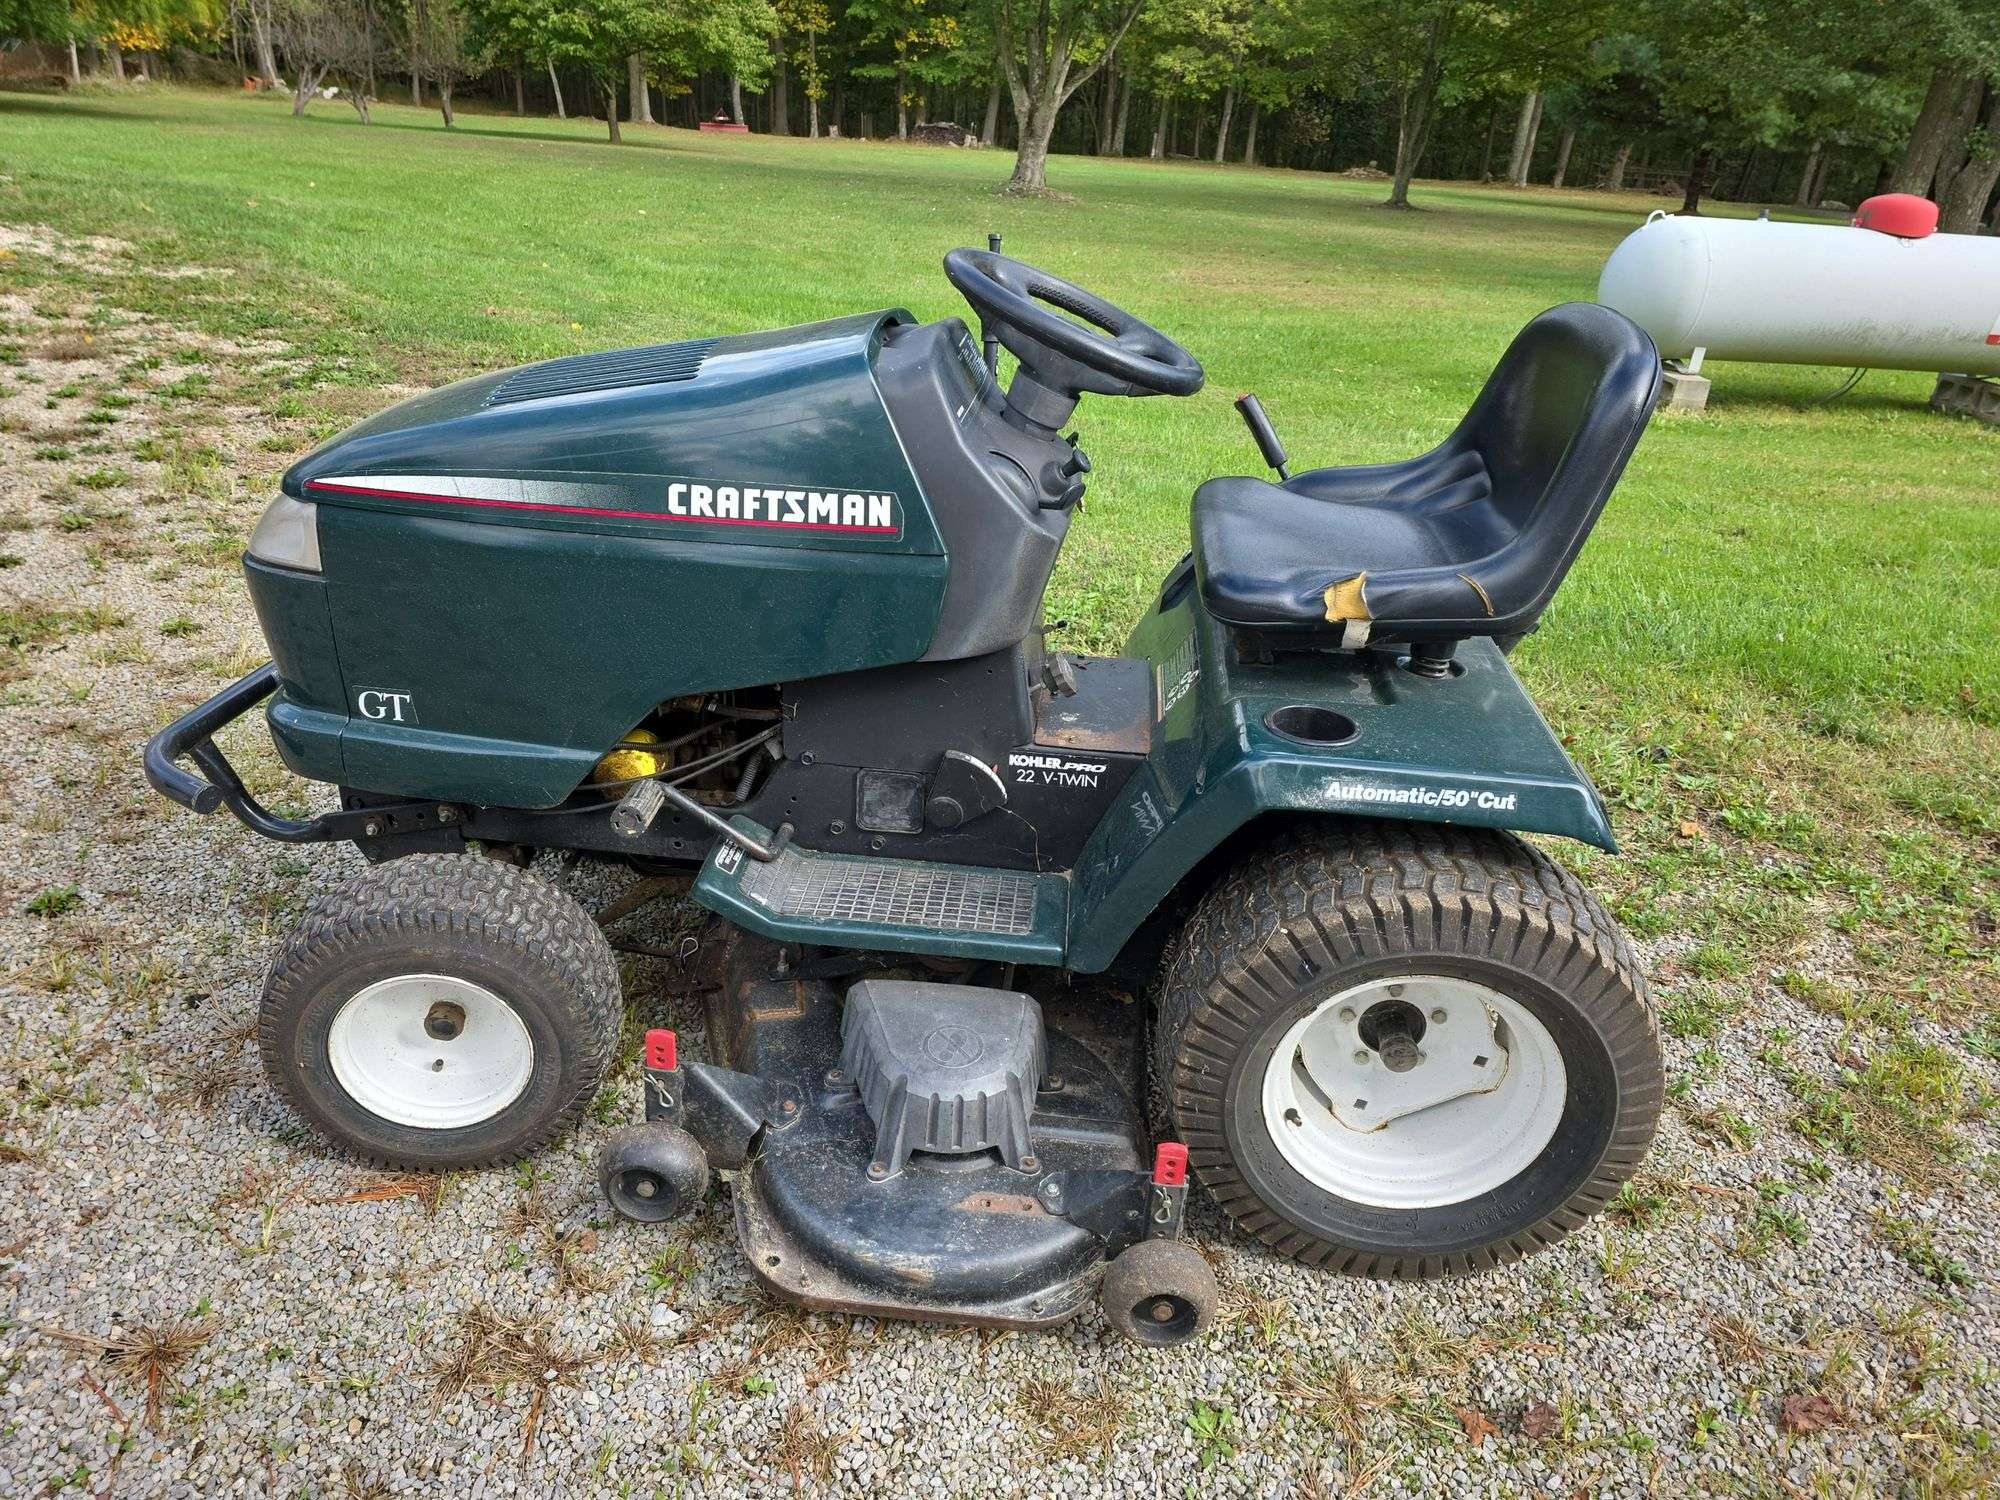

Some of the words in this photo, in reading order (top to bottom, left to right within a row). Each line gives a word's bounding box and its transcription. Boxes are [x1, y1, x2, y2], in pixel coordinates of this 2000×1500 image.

[667, 483, 891, 527] CRAFTSMAN
[358, 690, 410, 722] GT
[1008, 753, 1061, 770] KOHLER
[1016, 768, 1035, 783] 22
[1042, 770, 1098, 788] V-TWIN
